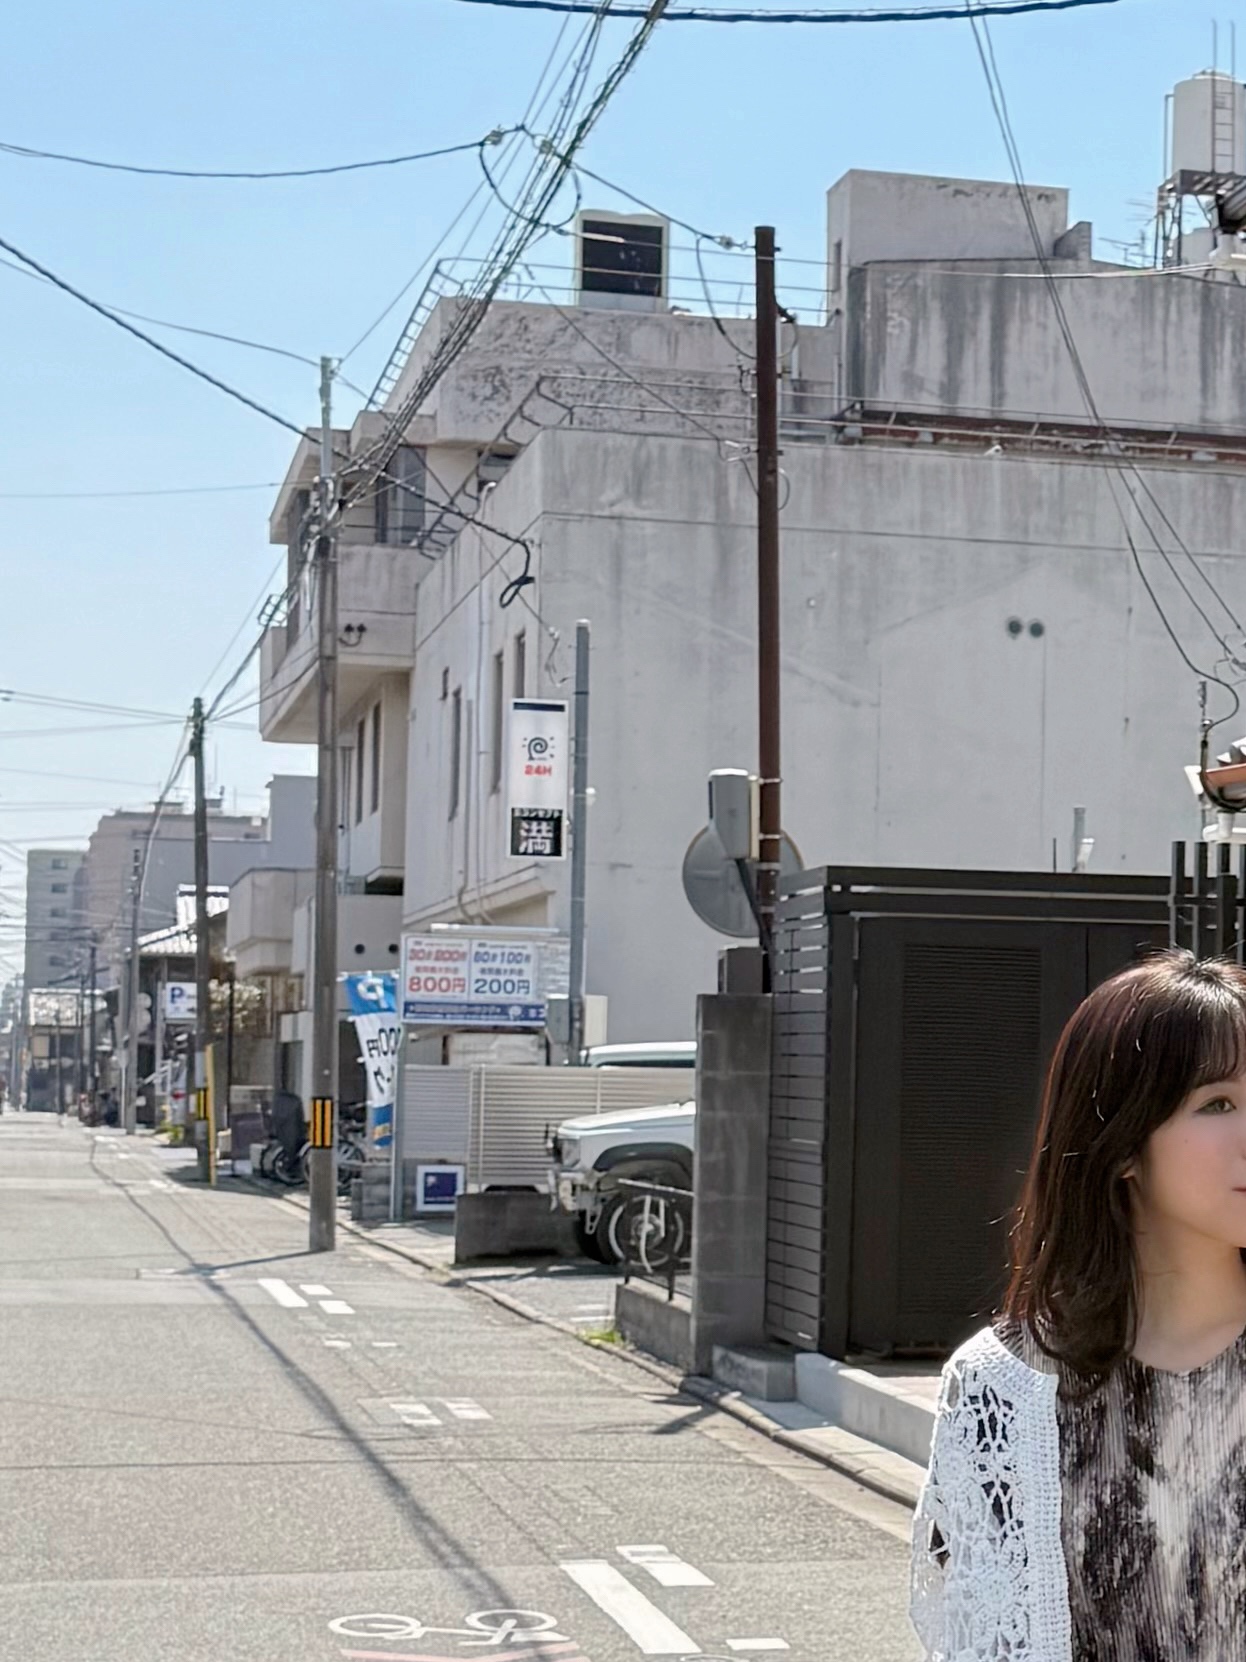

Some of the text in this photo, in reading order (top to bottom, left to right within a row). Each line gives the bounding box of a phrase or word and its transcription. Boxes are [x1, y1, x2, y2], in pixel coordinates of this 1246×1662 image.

[525, 764, 552, 776] 24H
[519, 820, 553, 854] 満
[409, 976, 466, 993] 800円
[474, 978, 530, 995] 200円
[171, 987, 184, 1004] P
